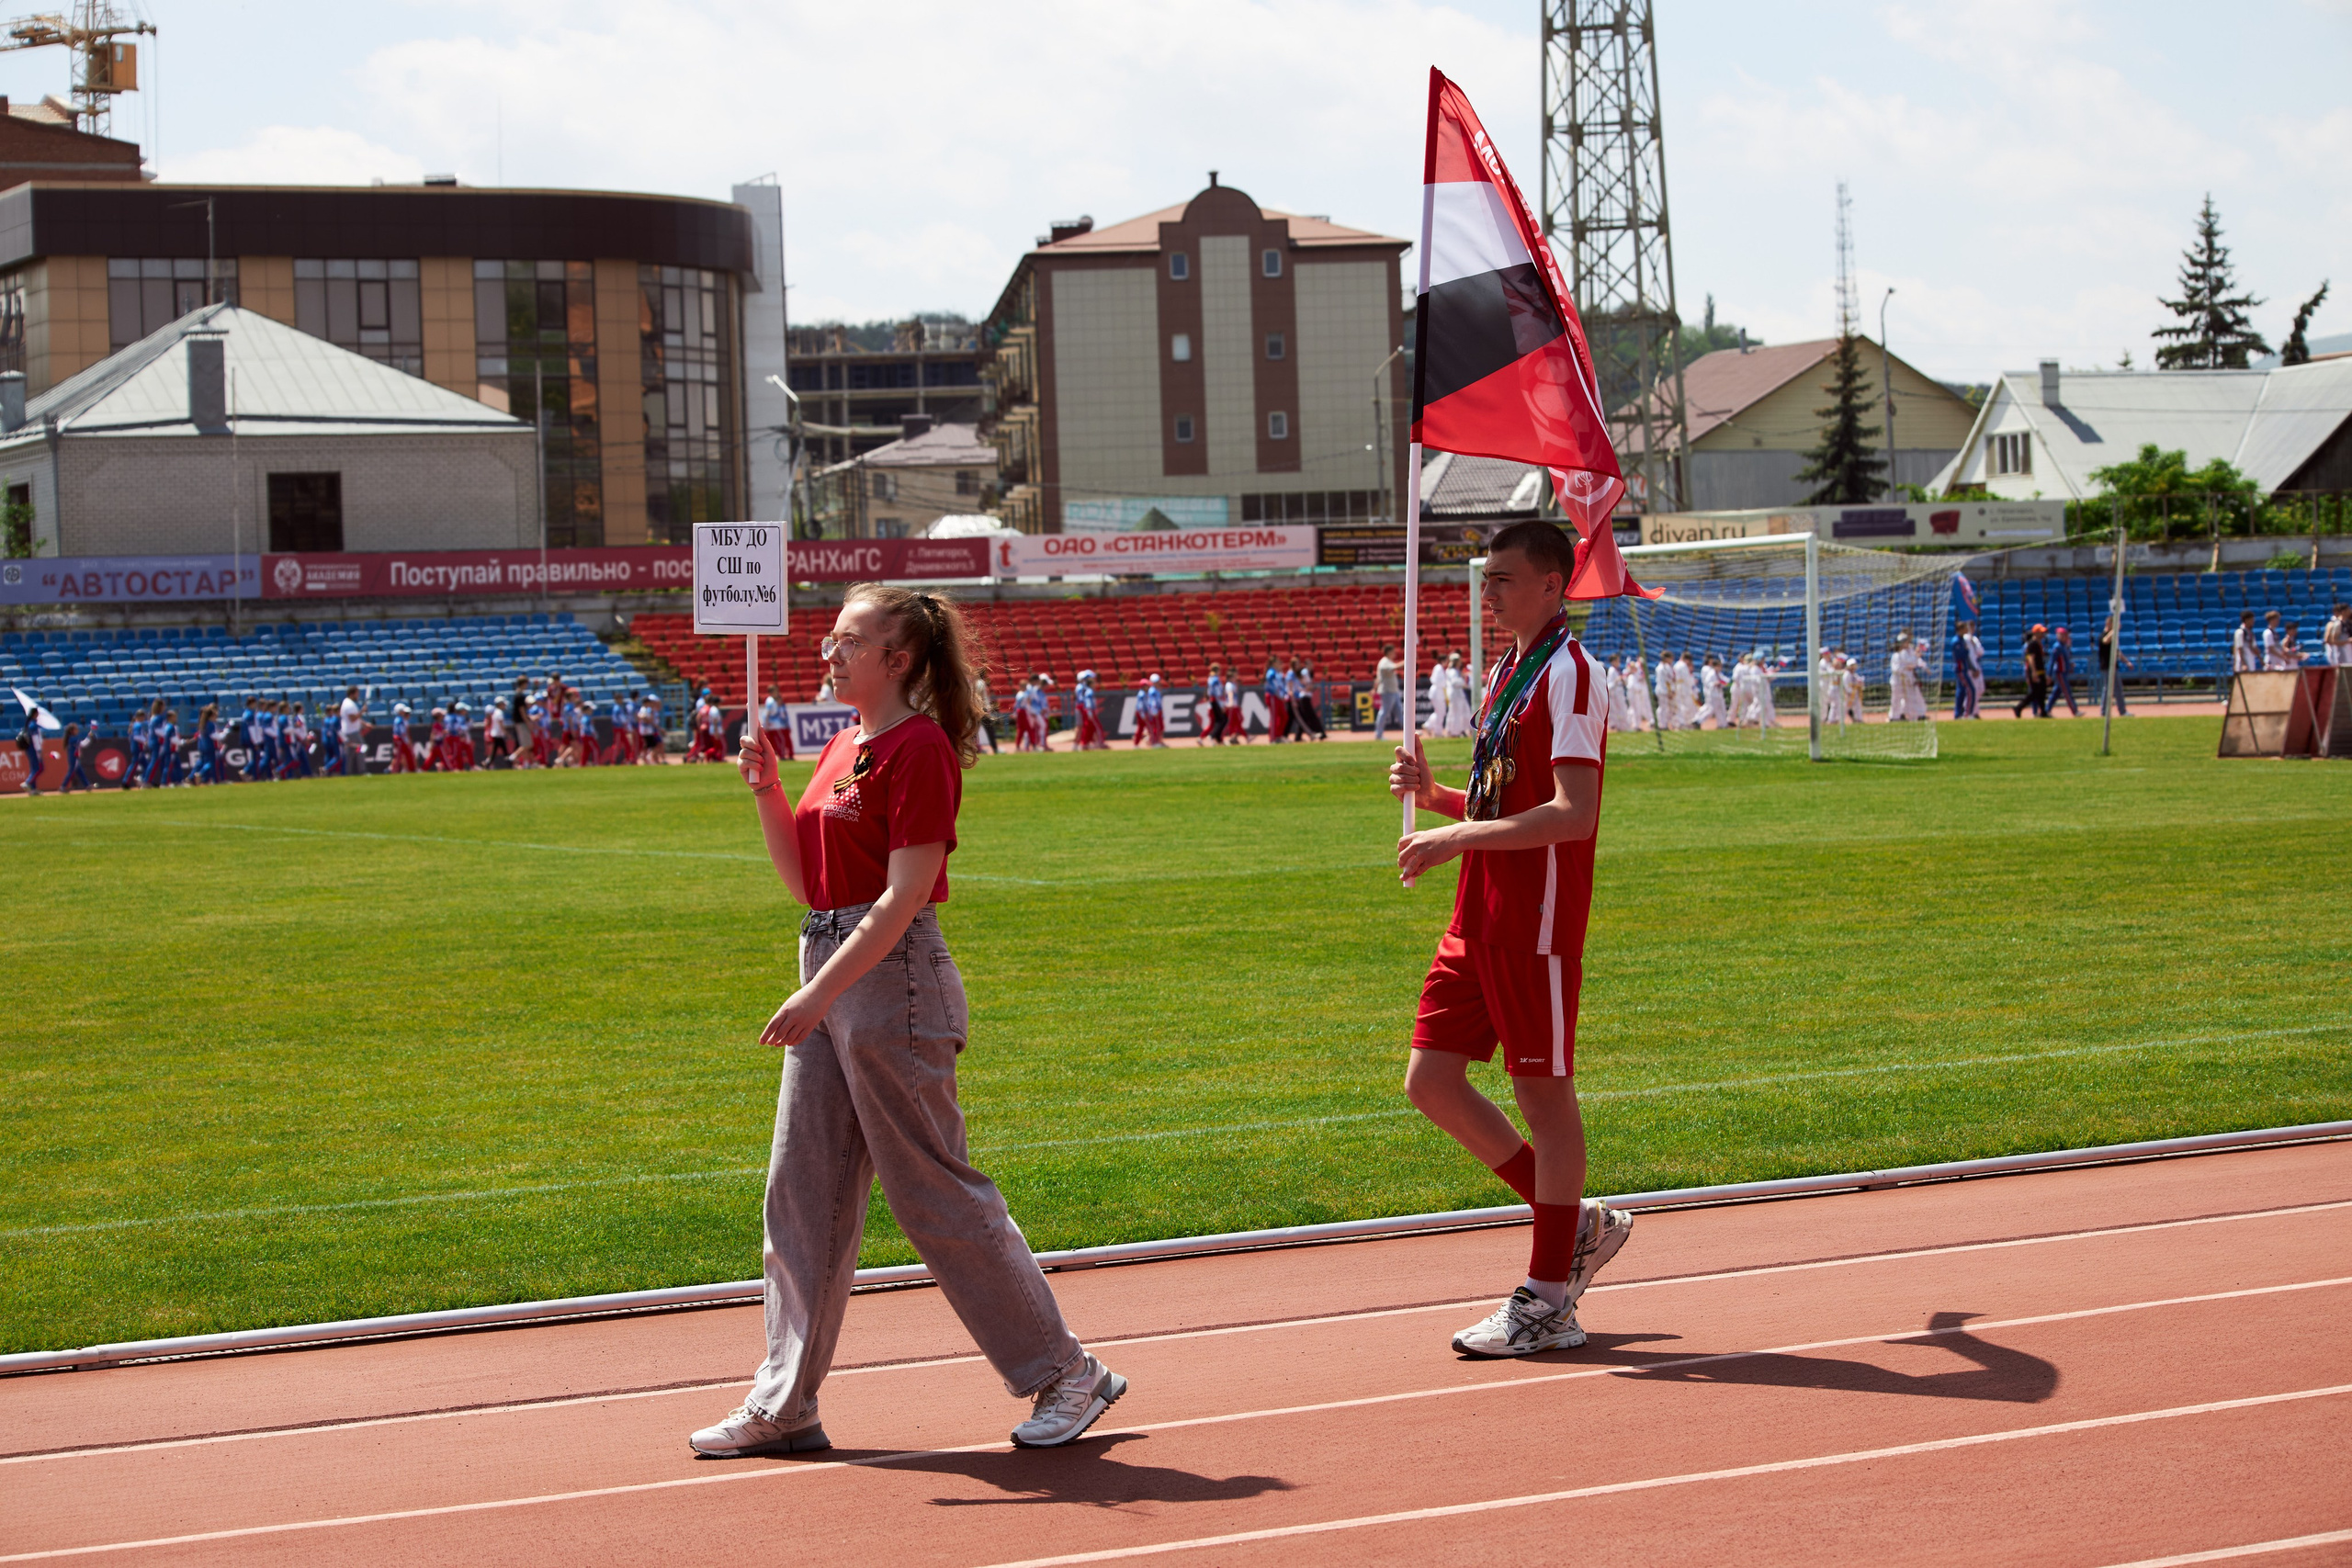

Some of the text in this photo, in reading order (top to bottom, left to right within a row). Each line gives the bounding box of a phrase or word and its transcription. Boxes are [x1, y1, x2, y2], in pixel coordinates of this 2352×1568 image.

[710, 529, 767, 550] МБУ ДО
[1045, 530, 1287, 556] ОАО «СТАНКОТЕРМ»
[1650, 524, 1746, 544] divan.ru
[390, 558, 503, 591] Поступай
[507, 556, 632, 588] правильно
[717, 557, 761, 574] СШ по
